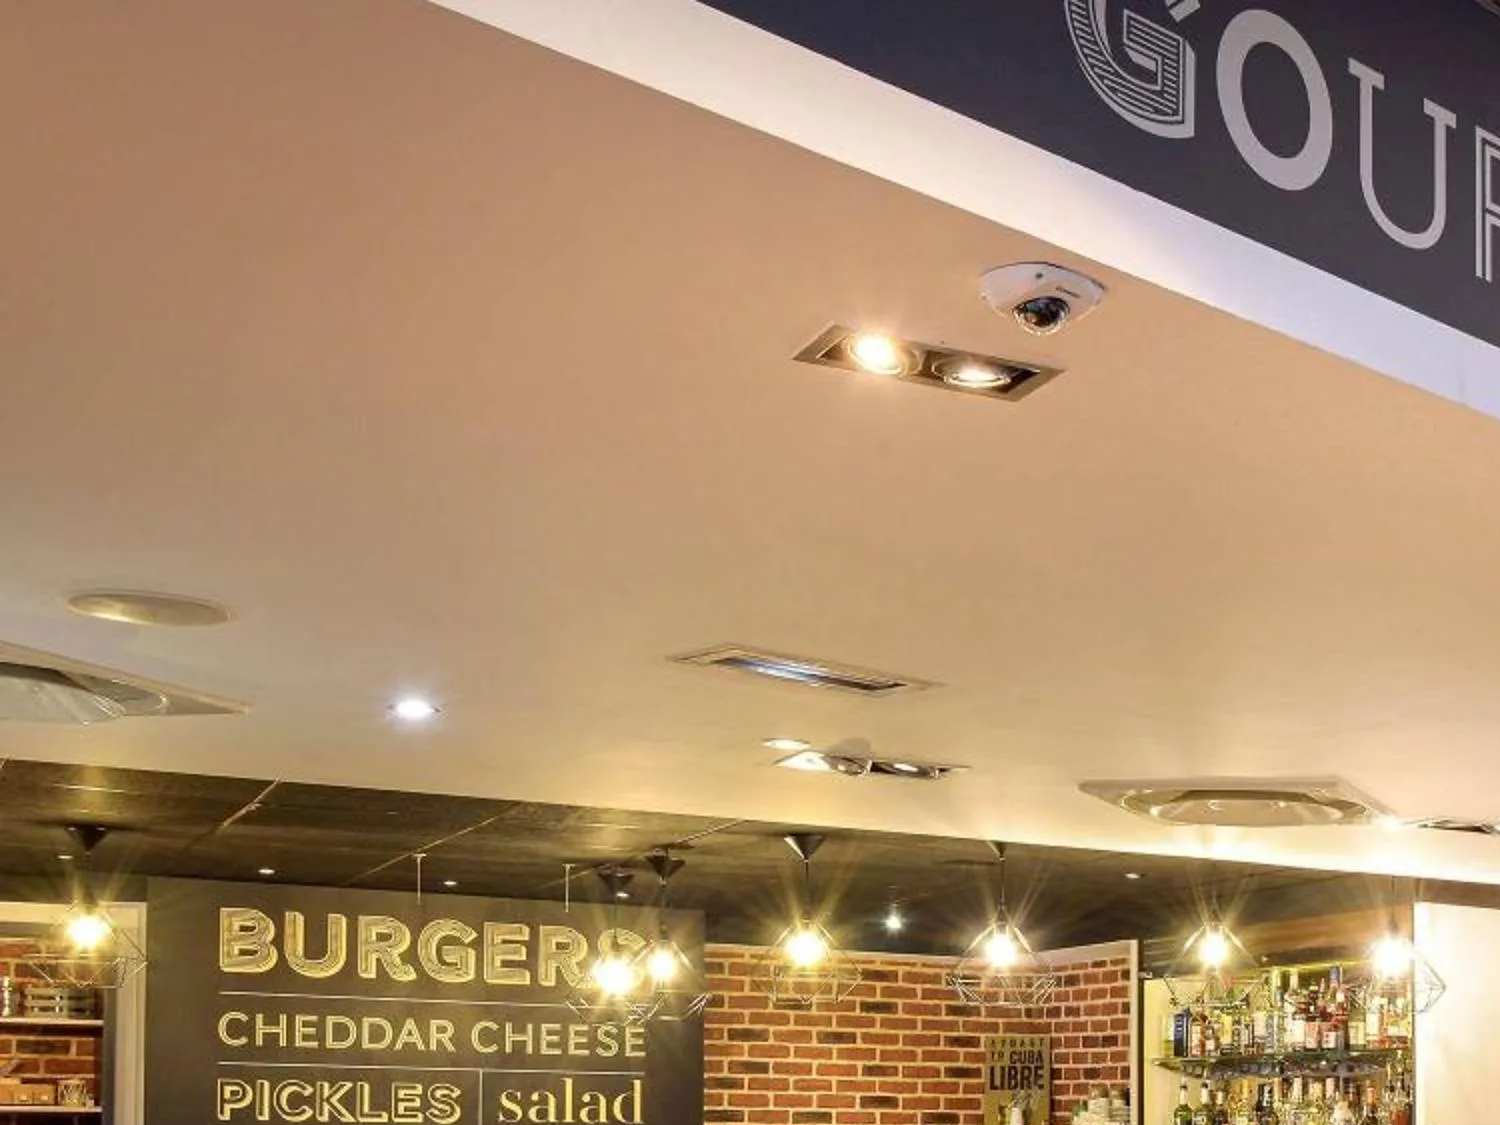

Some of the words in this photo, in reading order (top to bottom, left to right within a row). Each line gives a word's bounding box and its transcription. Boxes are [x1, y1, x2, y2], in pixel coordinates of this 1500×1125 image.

[218, 1011, 455, 1054] CHEDDAR
[471, 1023, 646, 1057] CHEESE
[990, 1066, 1044, 1090] LIBRE
[1010, 1050, 1043, 1064] CUBA
[217, 1079, 462, 1124] PICKLES
[498, 1077, 645, 1125] salad
